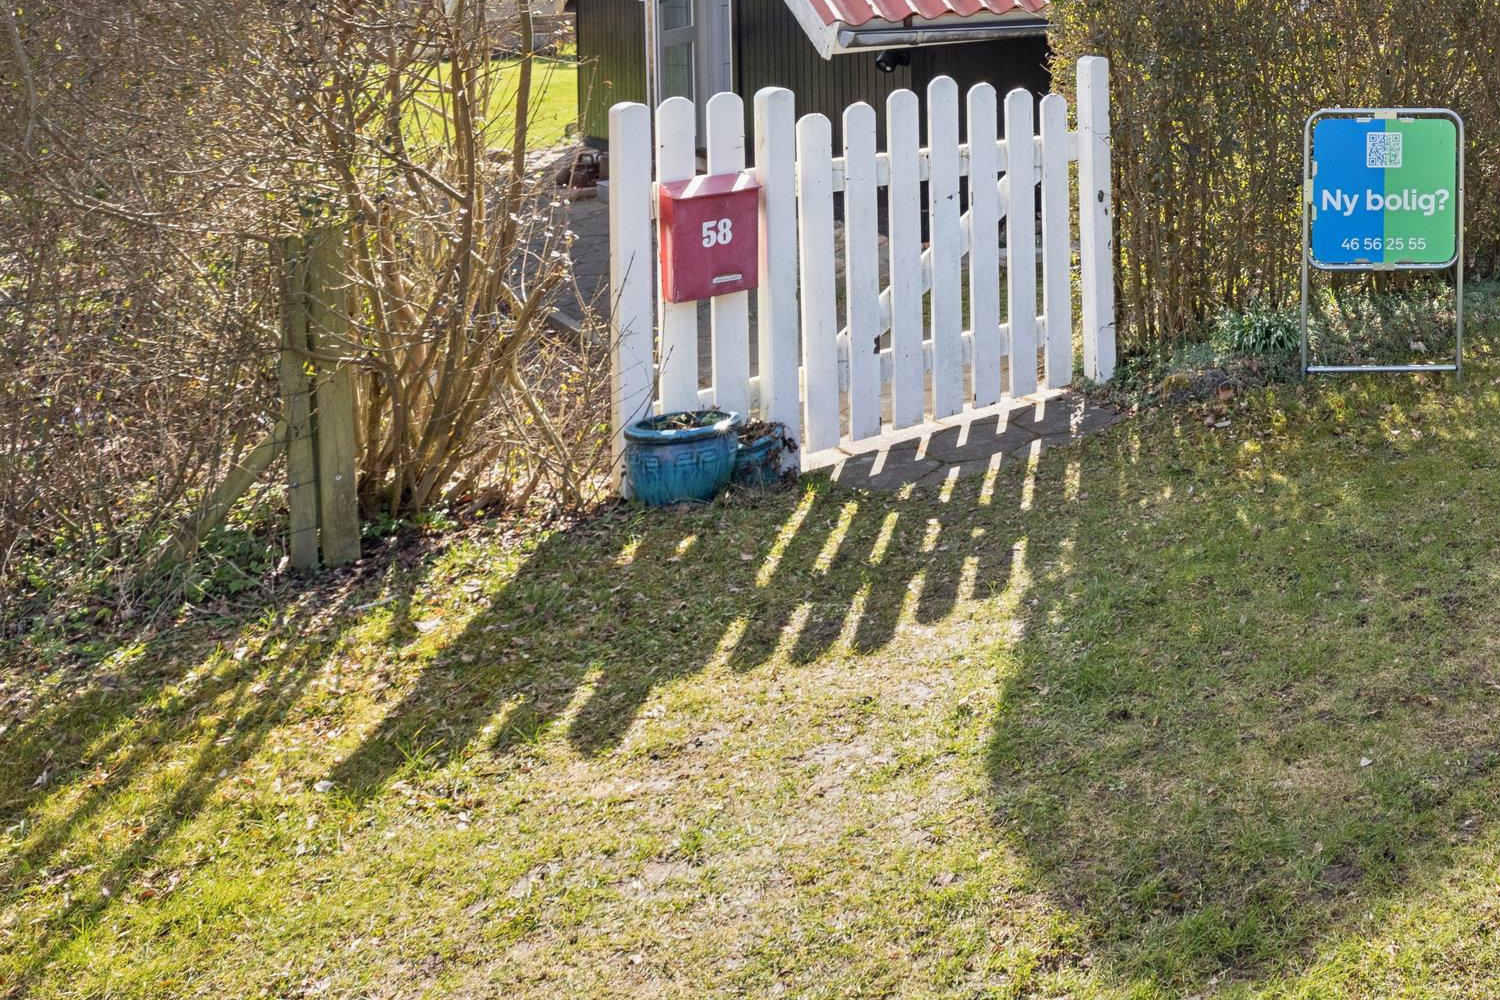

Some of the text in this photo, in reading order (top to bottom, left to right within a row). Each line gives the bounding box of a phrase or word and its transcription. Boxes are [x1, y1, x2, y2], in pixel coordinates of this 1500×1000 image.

[1321, 189, 1450, 216] Ny bolig?
[702, 218, 732, 248] 58
[1341, 238, 1426, 251] 46 56 25 55
